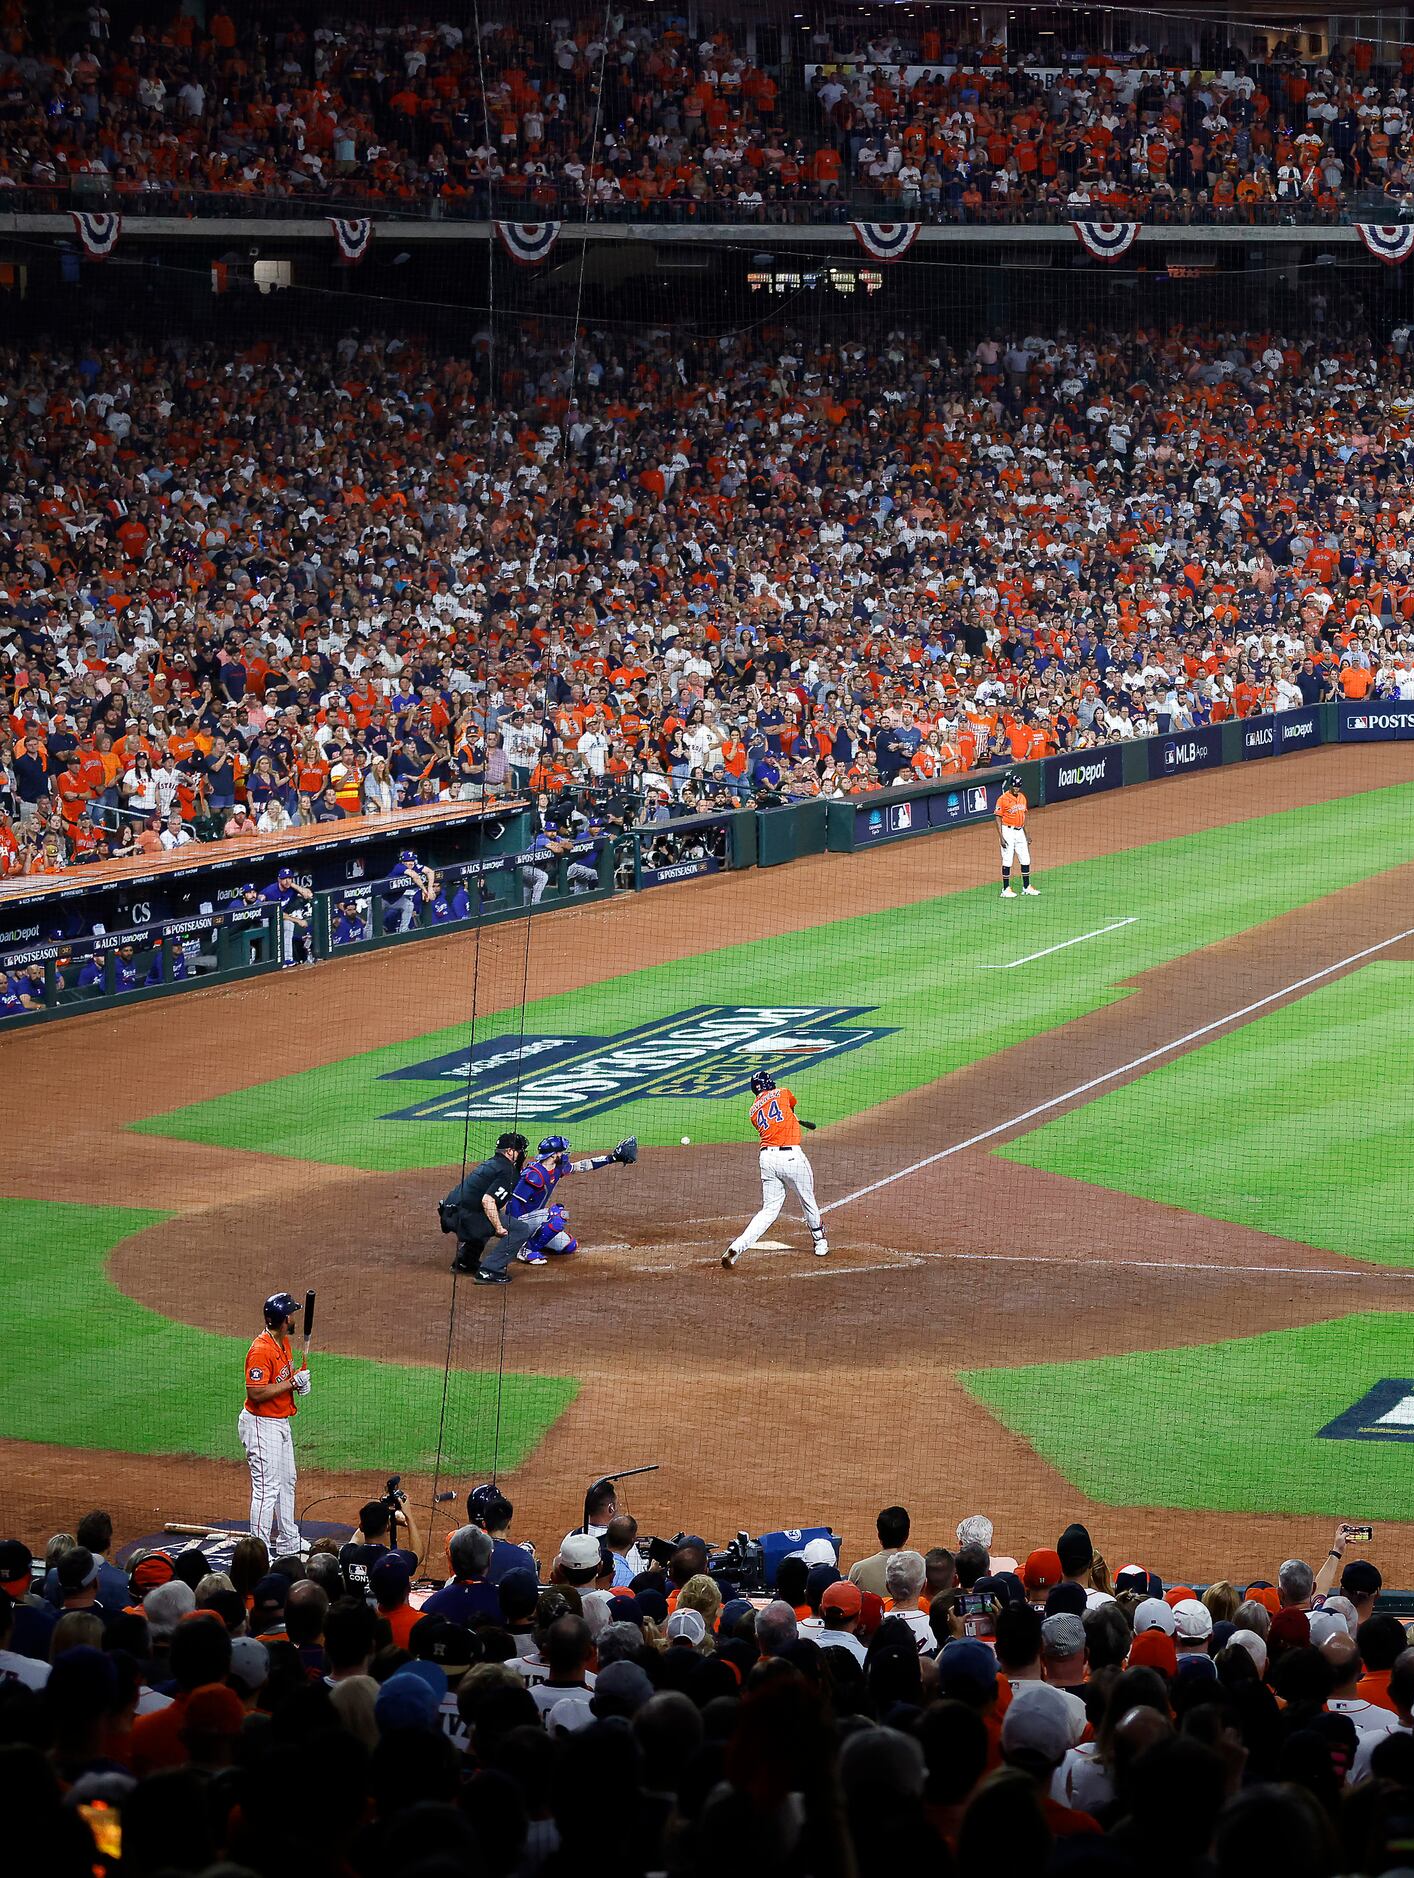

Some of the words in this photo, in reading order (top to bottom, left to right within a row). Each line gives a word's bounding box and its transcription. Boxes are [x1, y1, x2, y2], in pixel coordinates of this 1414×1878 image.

[1255, 728, 1273, 745] ALCS
[1282, 722, 1313, 741] loanDepot
[1175, 743, 1196, 765] MLB
[1196, 746, 1208, 760] App
[1058, 759, 1106, 788] loanDepot
[466, 863, 480, 874] ALCS
[664, 863, 698, 879] POSTSEASON
[343, 885, 372, 899] loanDepot
[232, 907, 262, 922] loanDepot
[0, 924, 40, 943] oanDepot
[171, 917, 213, 935] POSTSEASON
[101, 935, 118, 949] ALCS
[13, 947, 59, 965] POSTSEASON
[443, 1006, 820, 1119] POSTSEASON
[756, 1100, 784, 1131] 44
[349, 1574, 370, 1583] CONT
